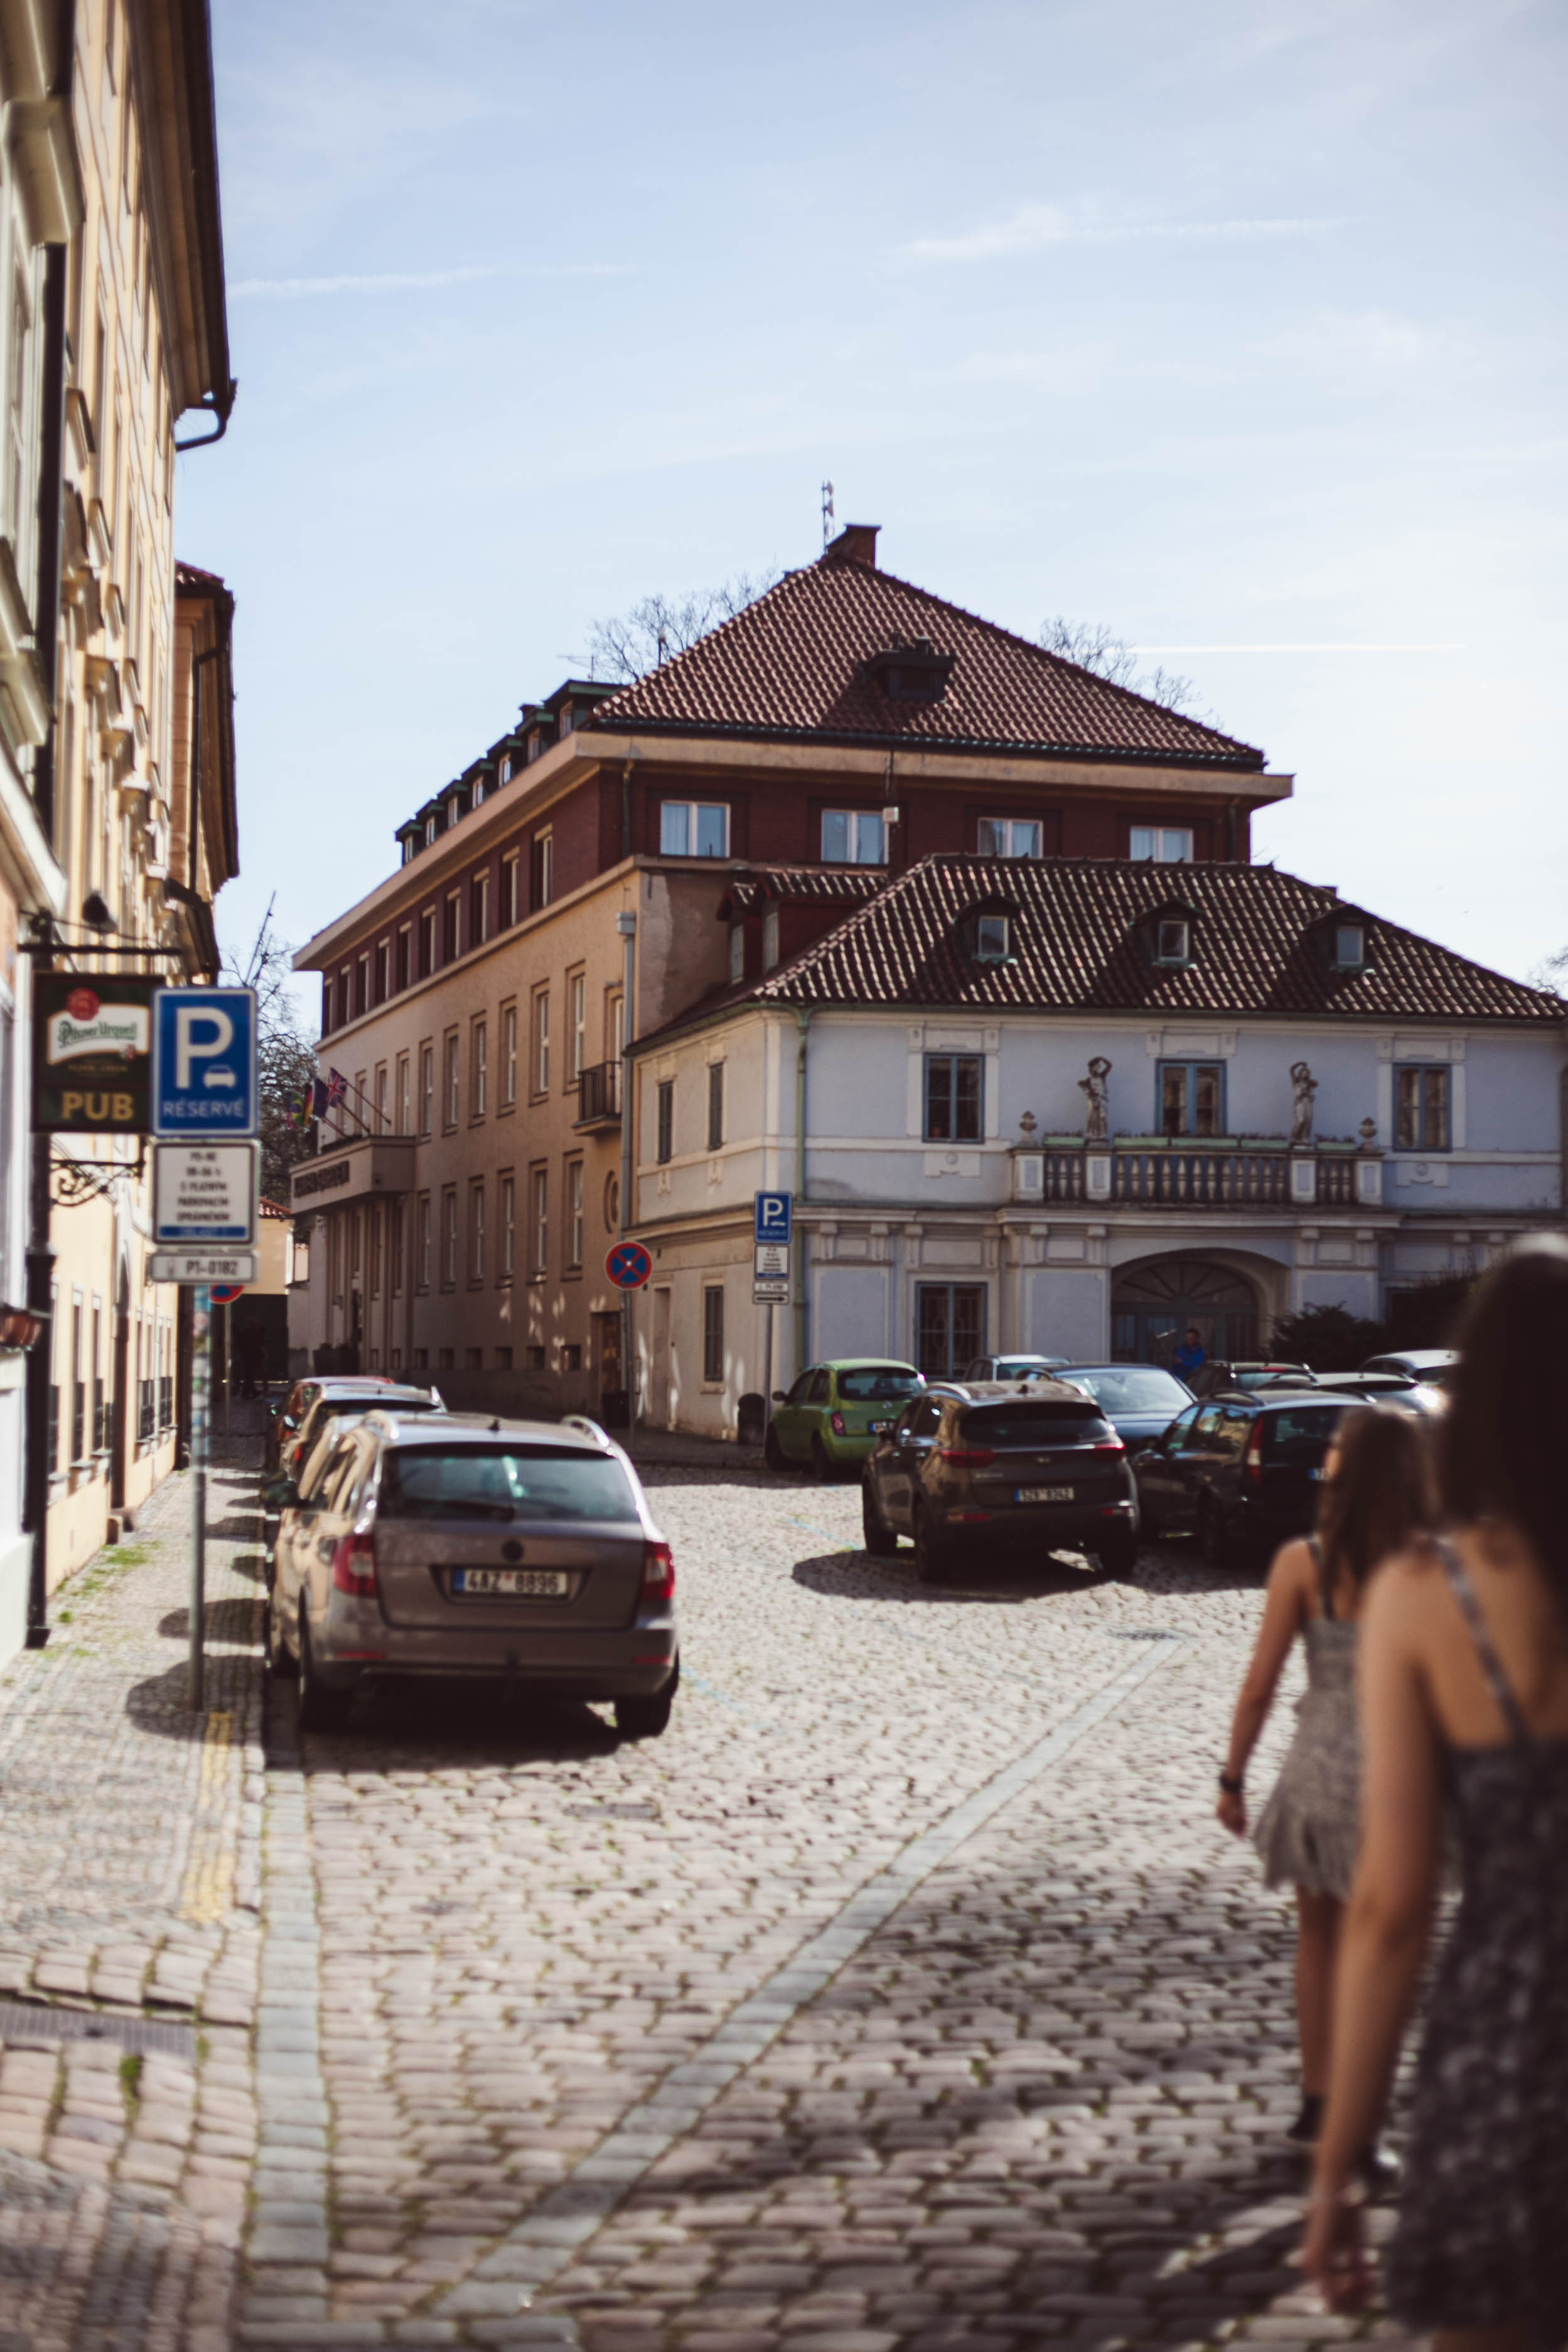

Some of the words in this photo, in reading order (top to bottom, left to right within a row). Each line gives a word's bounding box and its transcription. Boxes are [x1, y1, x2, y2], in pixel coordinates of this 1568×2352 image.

[176, 1007, 234, 1090] P
[63, 1091, 134, 1120] PUB
[163, 1097, 245, 1118] RÉSERVÉ
[763, 1198, 784, 1227] P
[186, 1260, 238, 1275] P1-0182
